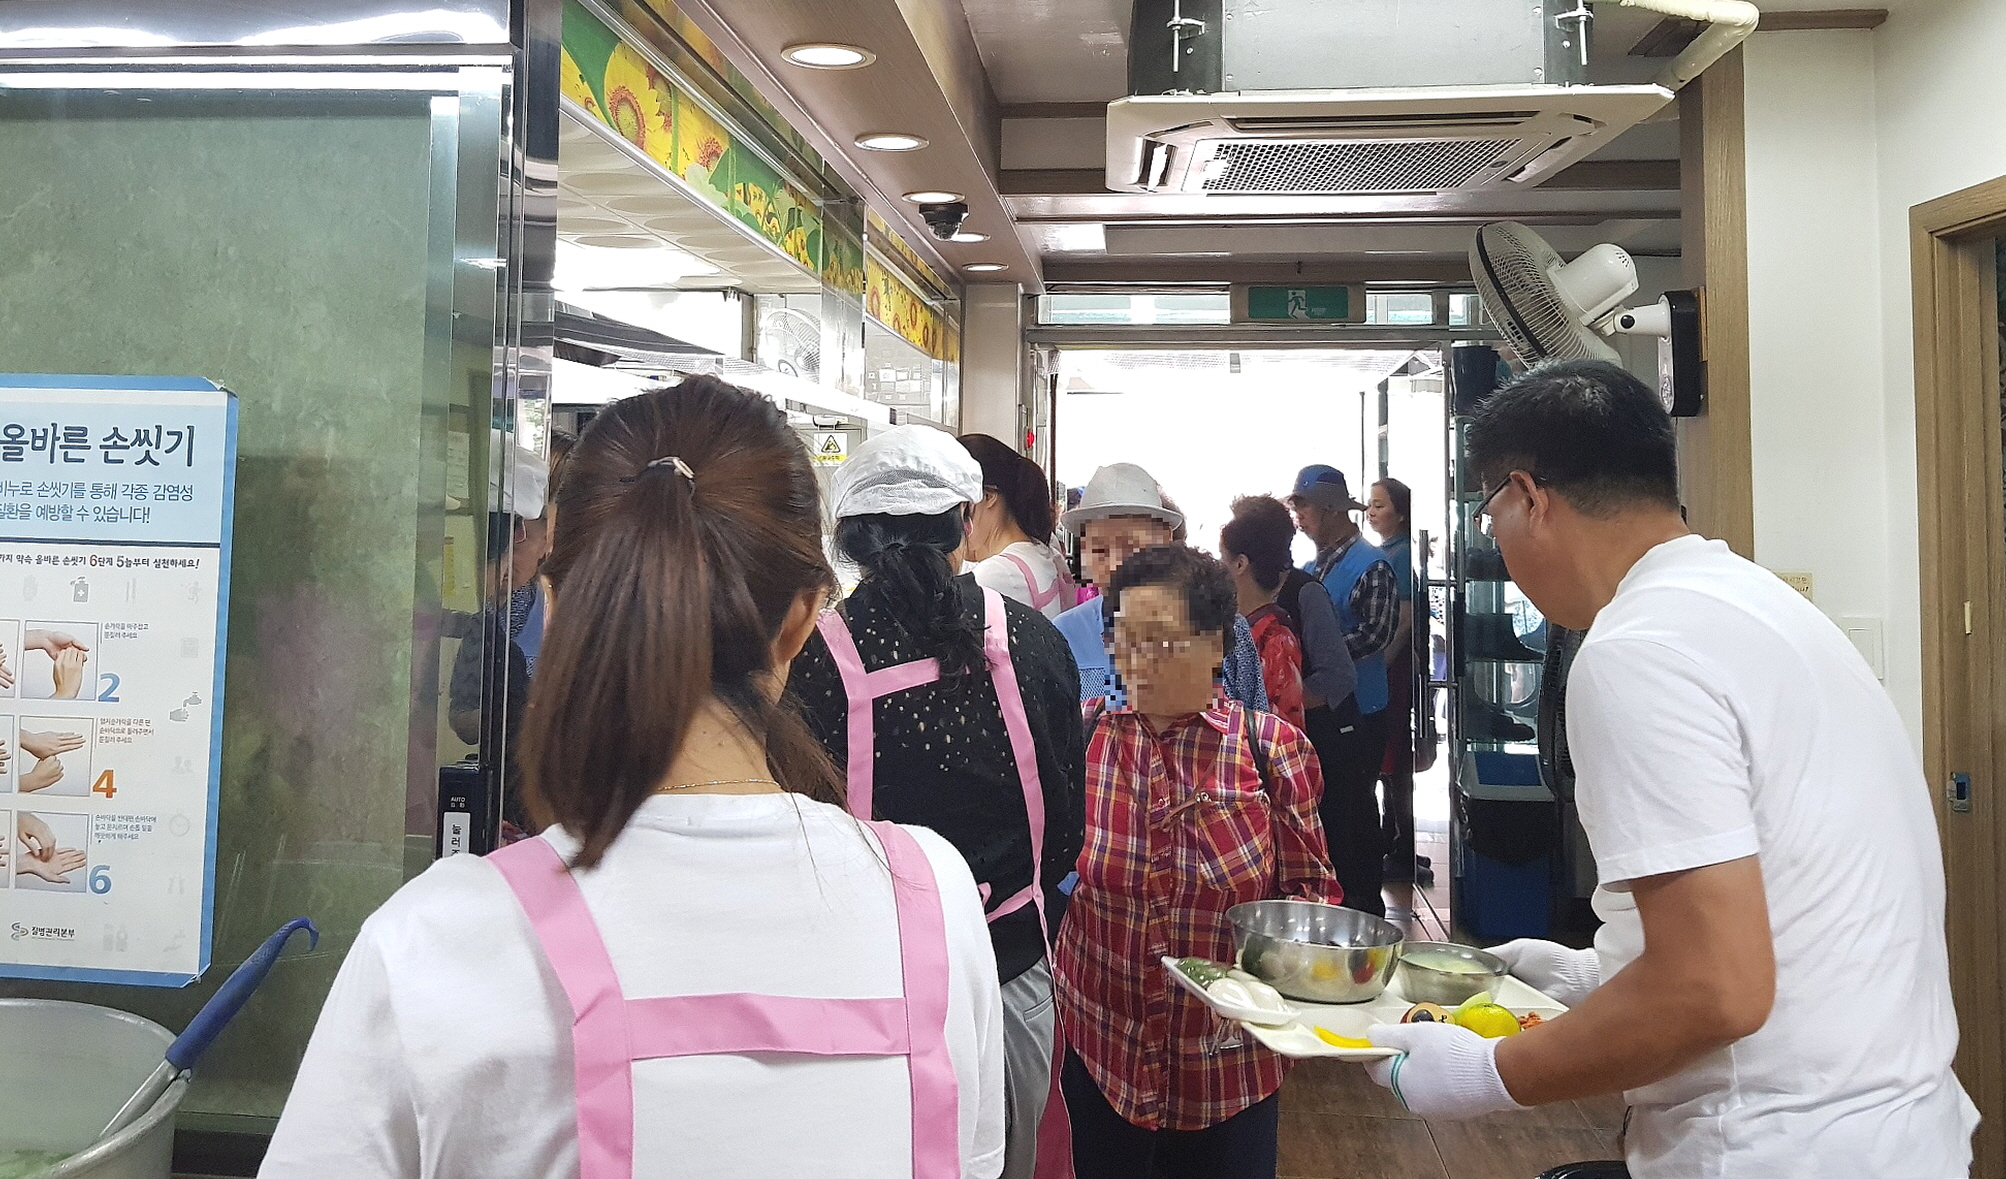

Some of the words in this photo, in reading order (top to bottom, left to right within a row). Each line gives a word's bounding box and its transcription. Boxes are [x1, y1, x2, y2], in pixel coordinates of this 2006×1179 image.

[0, 423, 91, 464] 올바른
[100, 425, 195, 467] 손씻기
[0, 480, 33, 497] 비누로
[37, 481, 86, 499] 손씻기를
[89, 483, 118, 500] 통해
[121, 484, 149, 501] 각종
[152, 484, 194, 501] 감염성
[36, 503, 74, 521] 예방할
[76, 505, 90, 522] 수
[92, 505, 151, 524] 있습니다!
[16, 554, 32, 564] 약속
[35, 554, 60, 566] 올바른
[62, 555, 86, 566] 손씻기
[153, 558, 200, 569] 실천하세요!
[98, 673, 120, 702] 2
[92, 769, 117, 798] 4
[89, 865, 112, 895] 6
[31, 926, 75, 938] 질병관리본부
